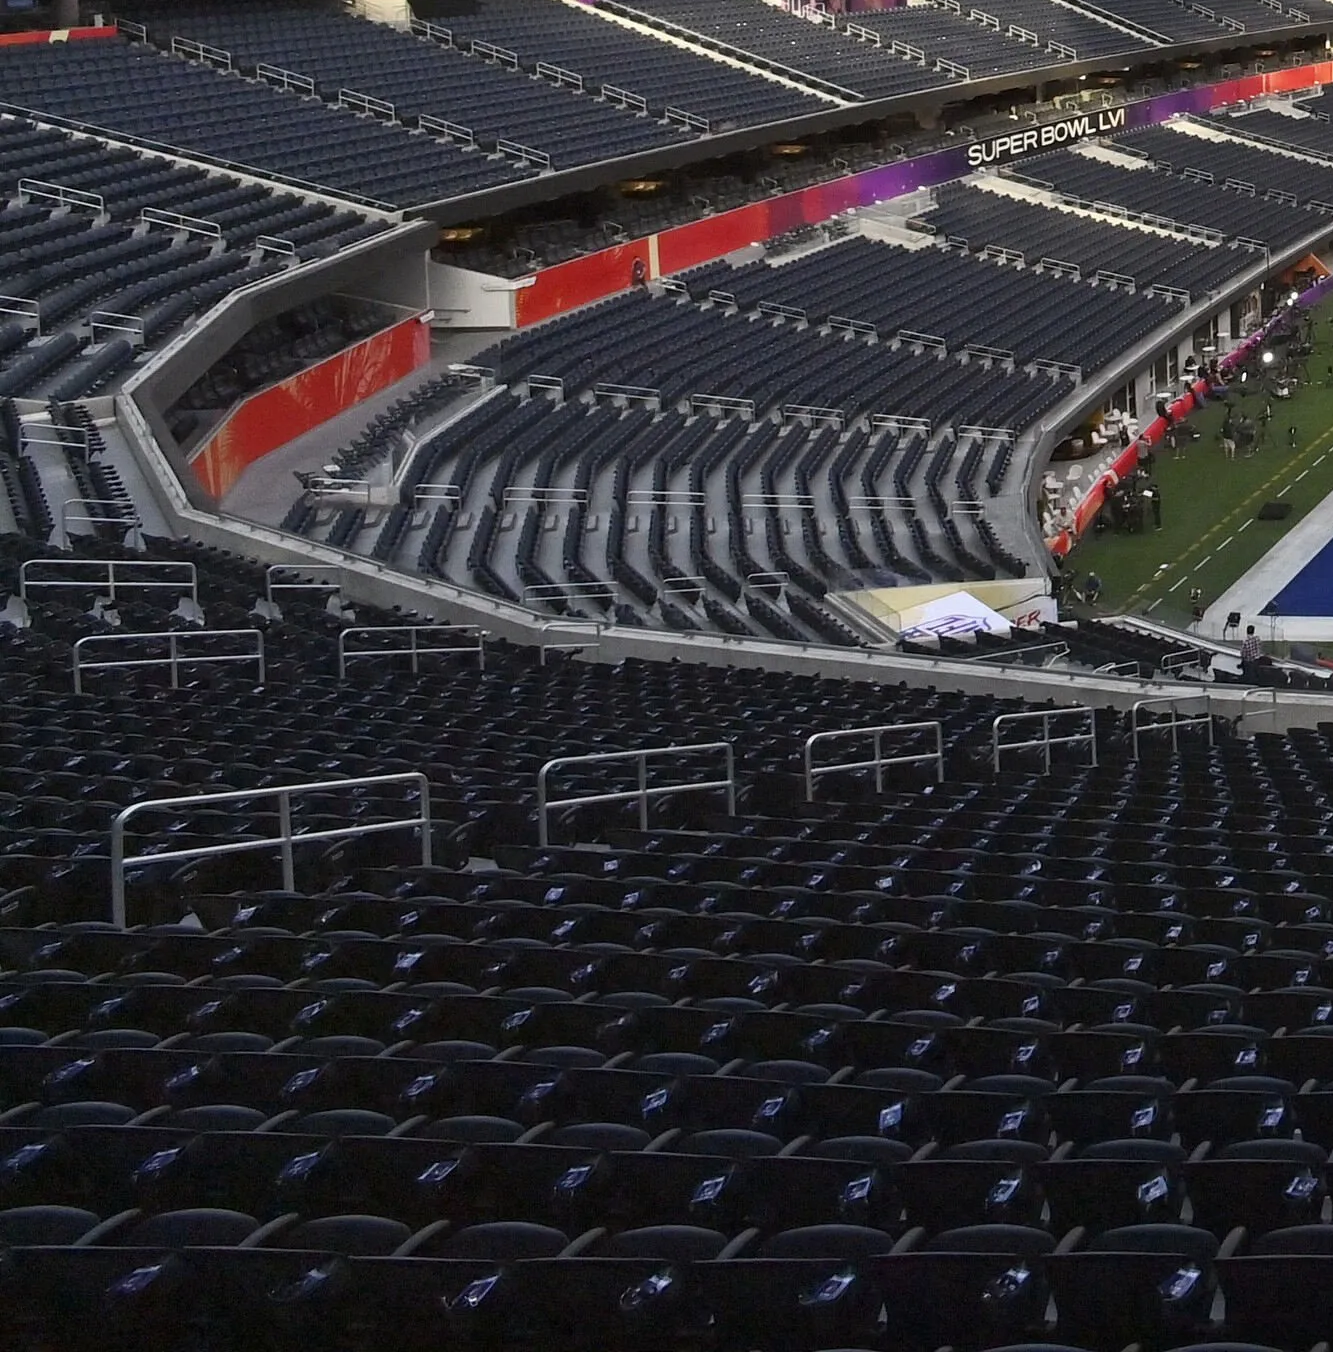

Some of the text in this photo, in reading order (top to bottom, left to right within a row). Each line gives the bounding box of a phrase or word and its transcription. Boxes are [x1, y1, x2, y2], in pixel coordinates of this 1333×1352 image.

[968, 108, 1124, 166] SUPER BOWL LVI
